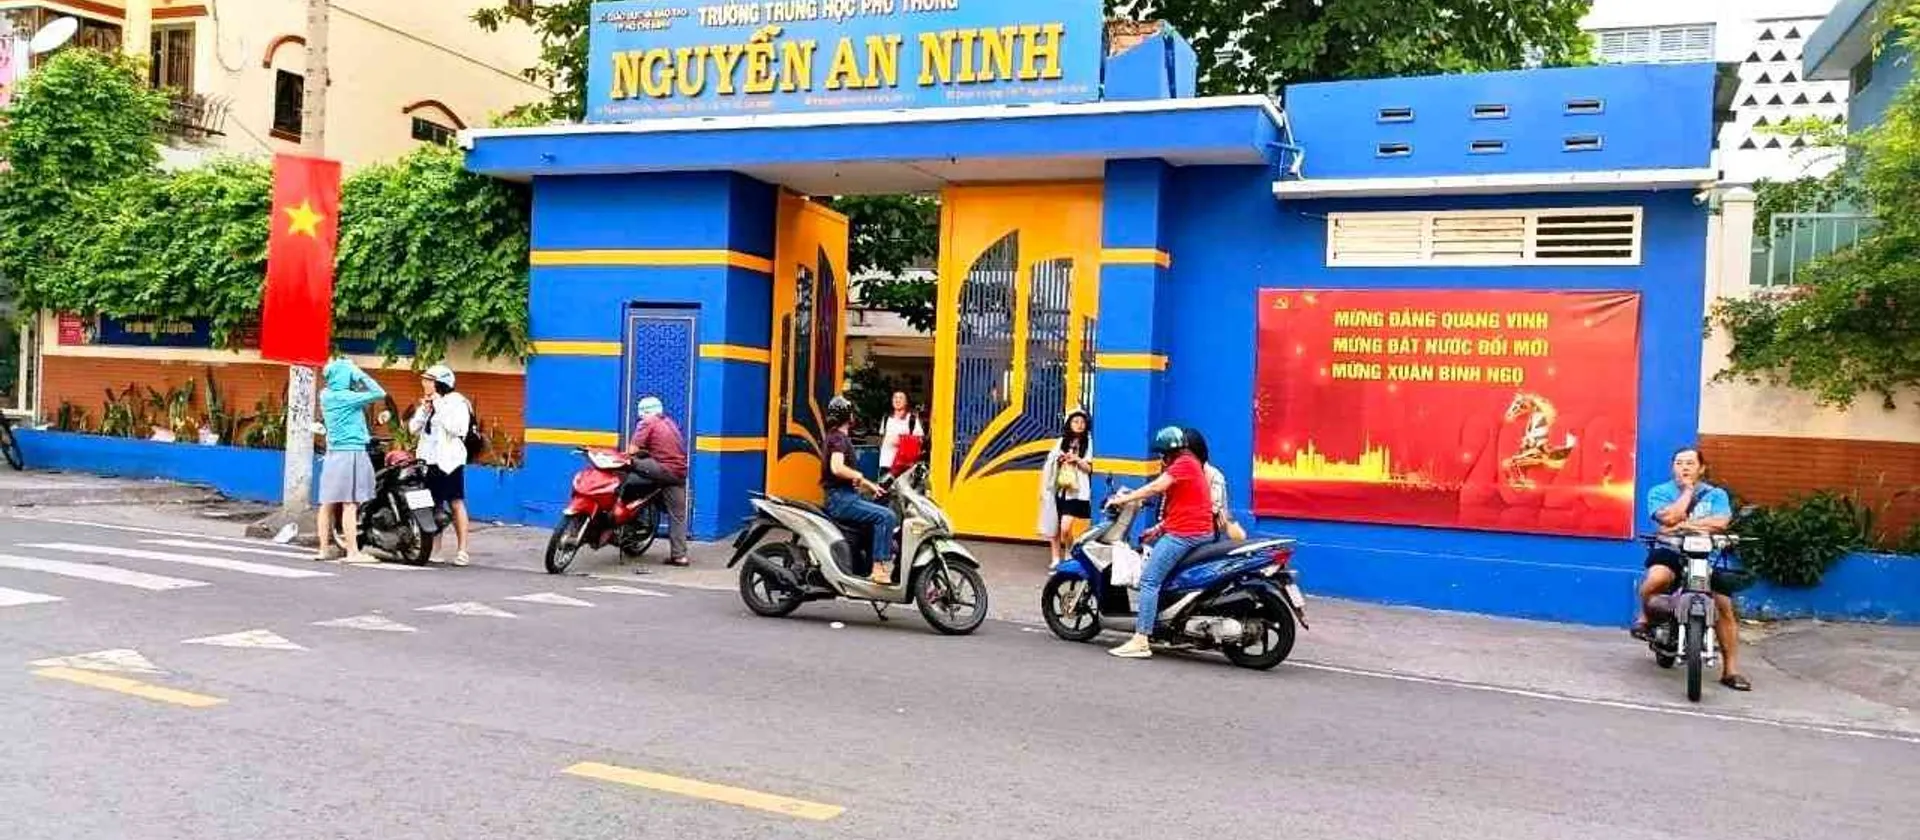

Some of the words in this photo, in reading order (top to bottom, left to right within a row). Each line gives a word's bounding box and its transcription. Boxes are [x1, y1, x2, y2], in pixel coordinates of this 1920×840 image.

[764, 0, 818, 22] TRUNG
[821, 0, 856, 24] HỌC
[609, 24, 817, 100] NGUYỄN
[825, 33, 902, 90] AN
[917, 22, 1065, 86] NINH
[1334, 308, 1384, 328] MỪNG
[1388, 307, 1437, 328] ĐẢNG
[1441, 311, 1500, 330] QUANG
[1506, 311, 1548, 329] VINH
[1333, 334, 1383, 354] MỪNG
[1387, 335, 1420, 354] ĐẤT
[1425, 336, 1472, 356] NƯỚC
[1478, 333, 1508, 356] ĐỔI
[1514, 336, 1548, 357] MỚI
[1331, 360, 1381, 380] MỪNG
[1387, 361, 1434, 381] XUÂN
[1487, 366, 1524, 386] NGỌ
